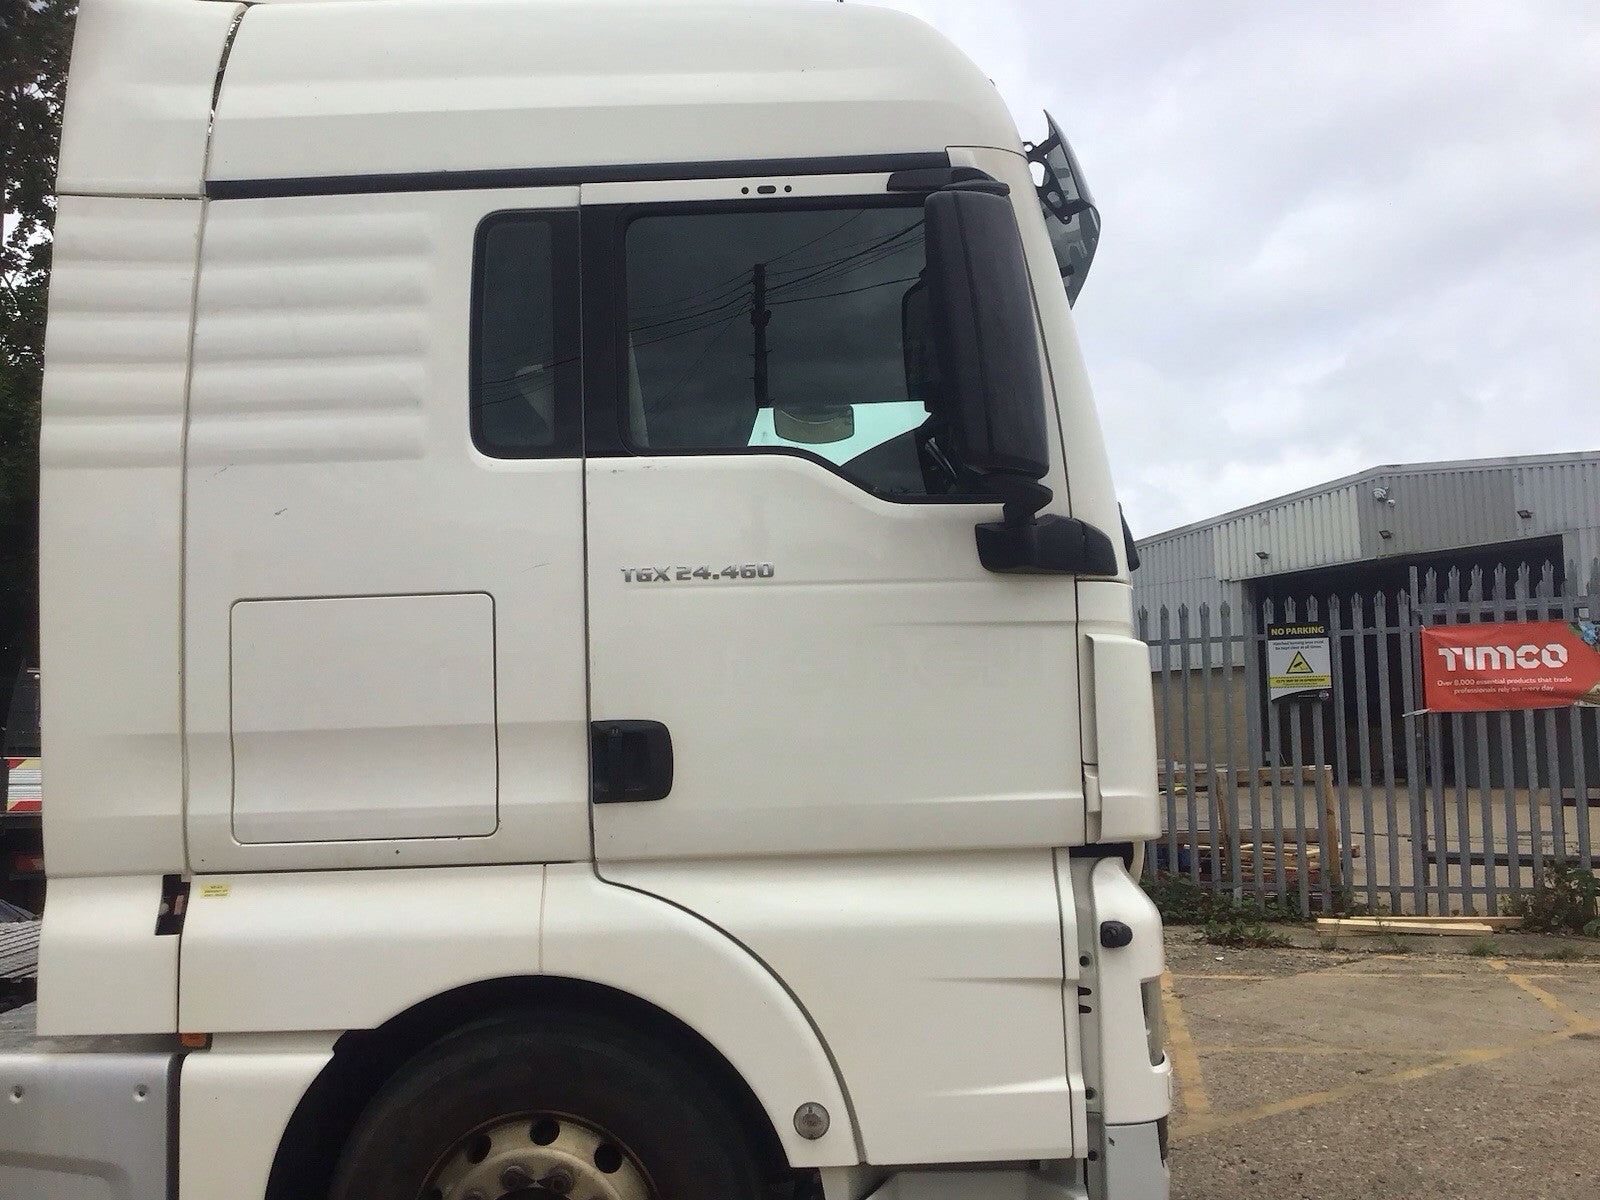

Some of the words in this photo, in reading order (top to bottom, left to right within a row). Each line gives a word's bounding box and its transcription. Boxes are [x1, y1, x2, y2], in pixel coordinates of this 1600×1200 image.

[621, 565, 670, 582] TGX
[676, 562, 774, 580] 24.460
[1271, 628, 1284, 636] NO
[1286, 626, 1324, 635] PARKING
